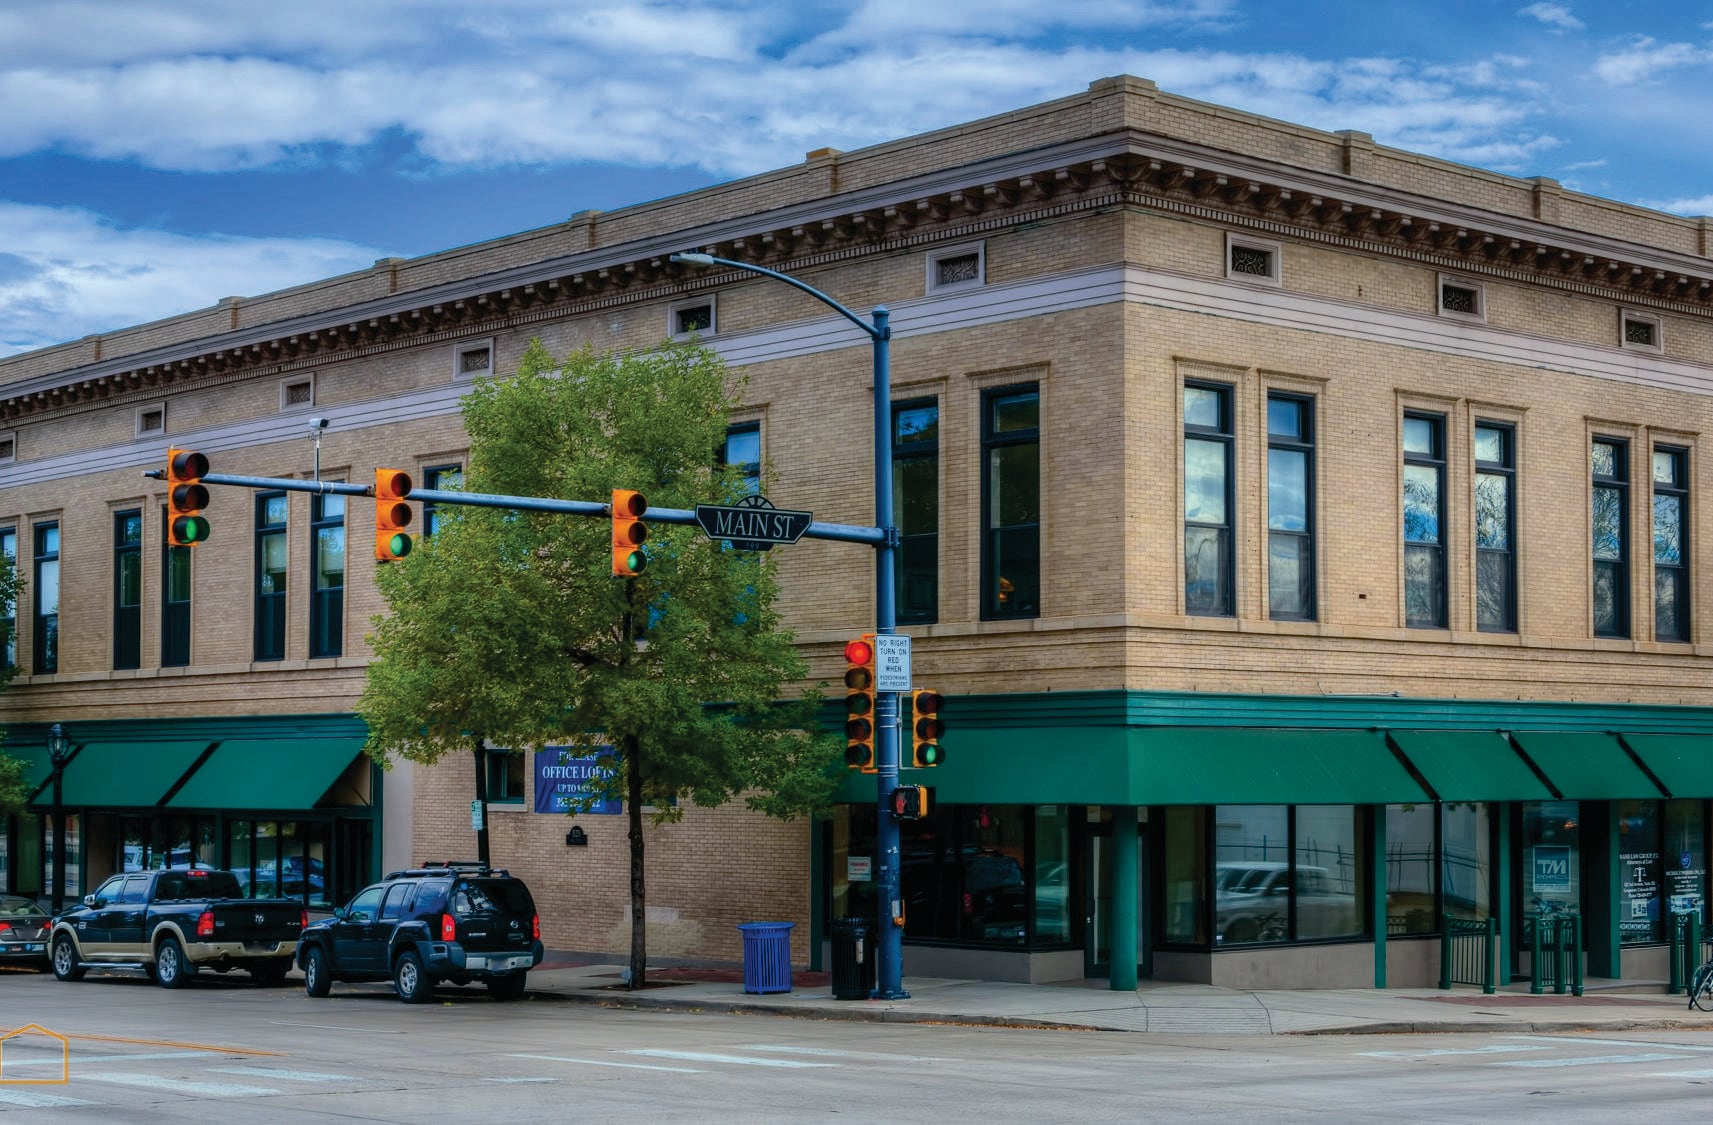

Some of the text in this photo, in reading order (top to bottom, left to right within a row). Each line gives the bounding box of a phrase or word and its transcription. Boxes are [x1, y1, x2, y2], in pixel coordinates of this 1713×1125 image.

[715, 511, 795, 539] MAIN ST
[878, 639, 908, 647] NO RIGHT
[887, 656, 900, 664] RED
[542, 766, 579, 779] OFFICE
[557, 784, 567, 793] UP
[567, 784, 577, 793] TO
[1536, 859, 1567, 874] TM
